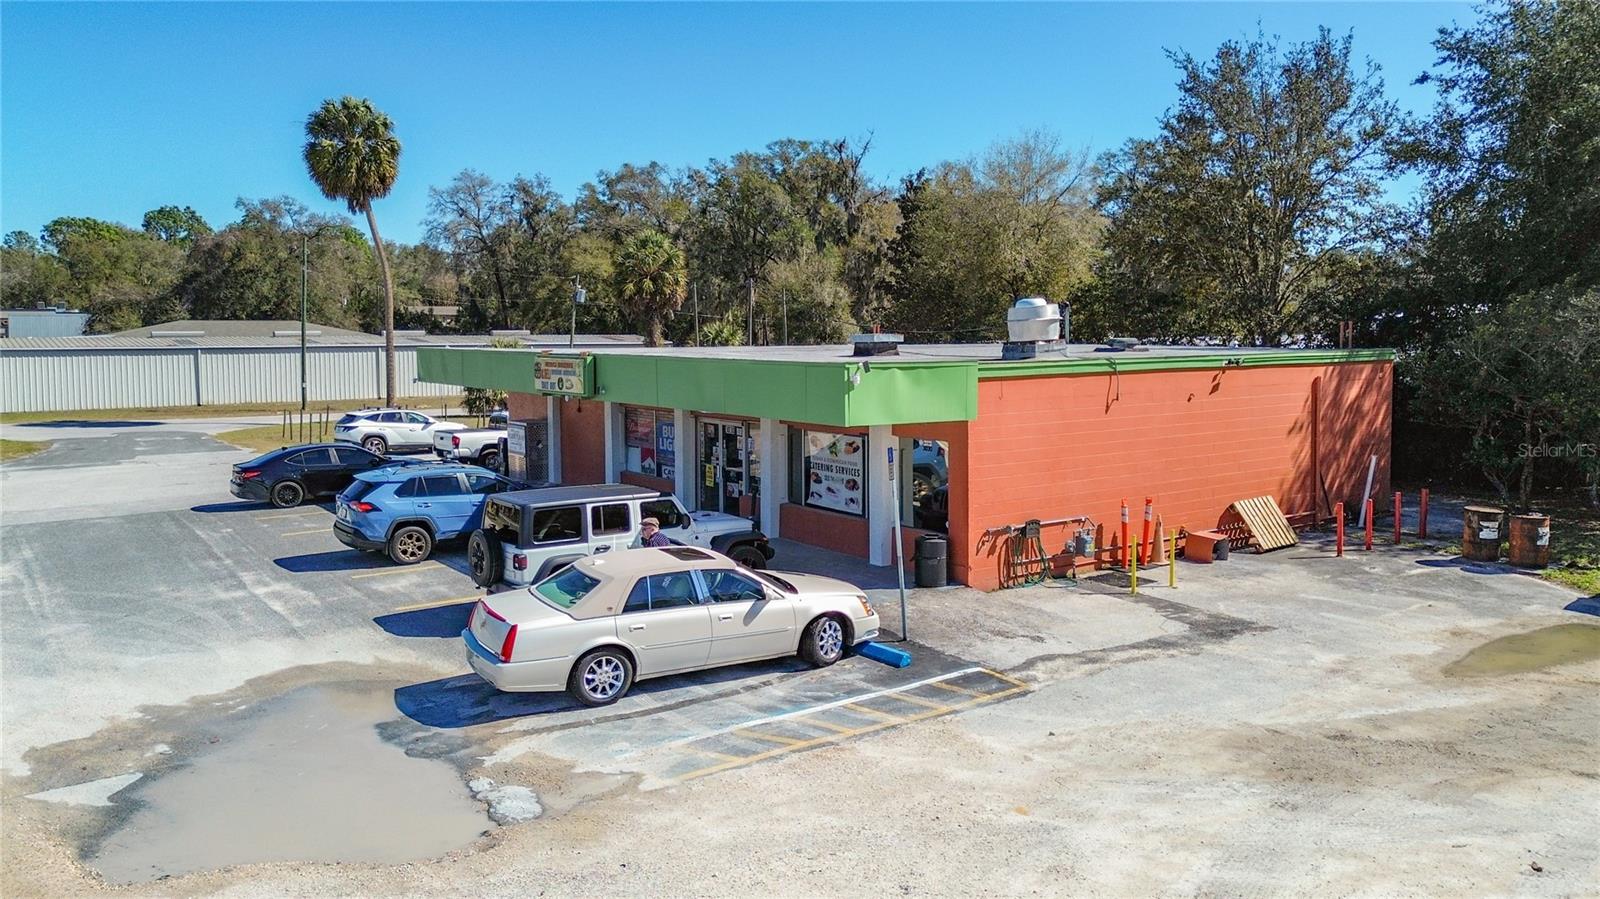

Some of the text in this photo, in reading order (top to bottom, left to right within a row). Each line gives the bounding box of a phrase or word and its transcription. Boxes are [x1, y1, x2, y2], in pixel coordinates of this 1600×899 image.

[662, 425, 674, 438] BU
[659, 438, 674, 451] LIG
[663, 467, 675, 476] CAT
[835, 465, 860, 478] SERVICES
